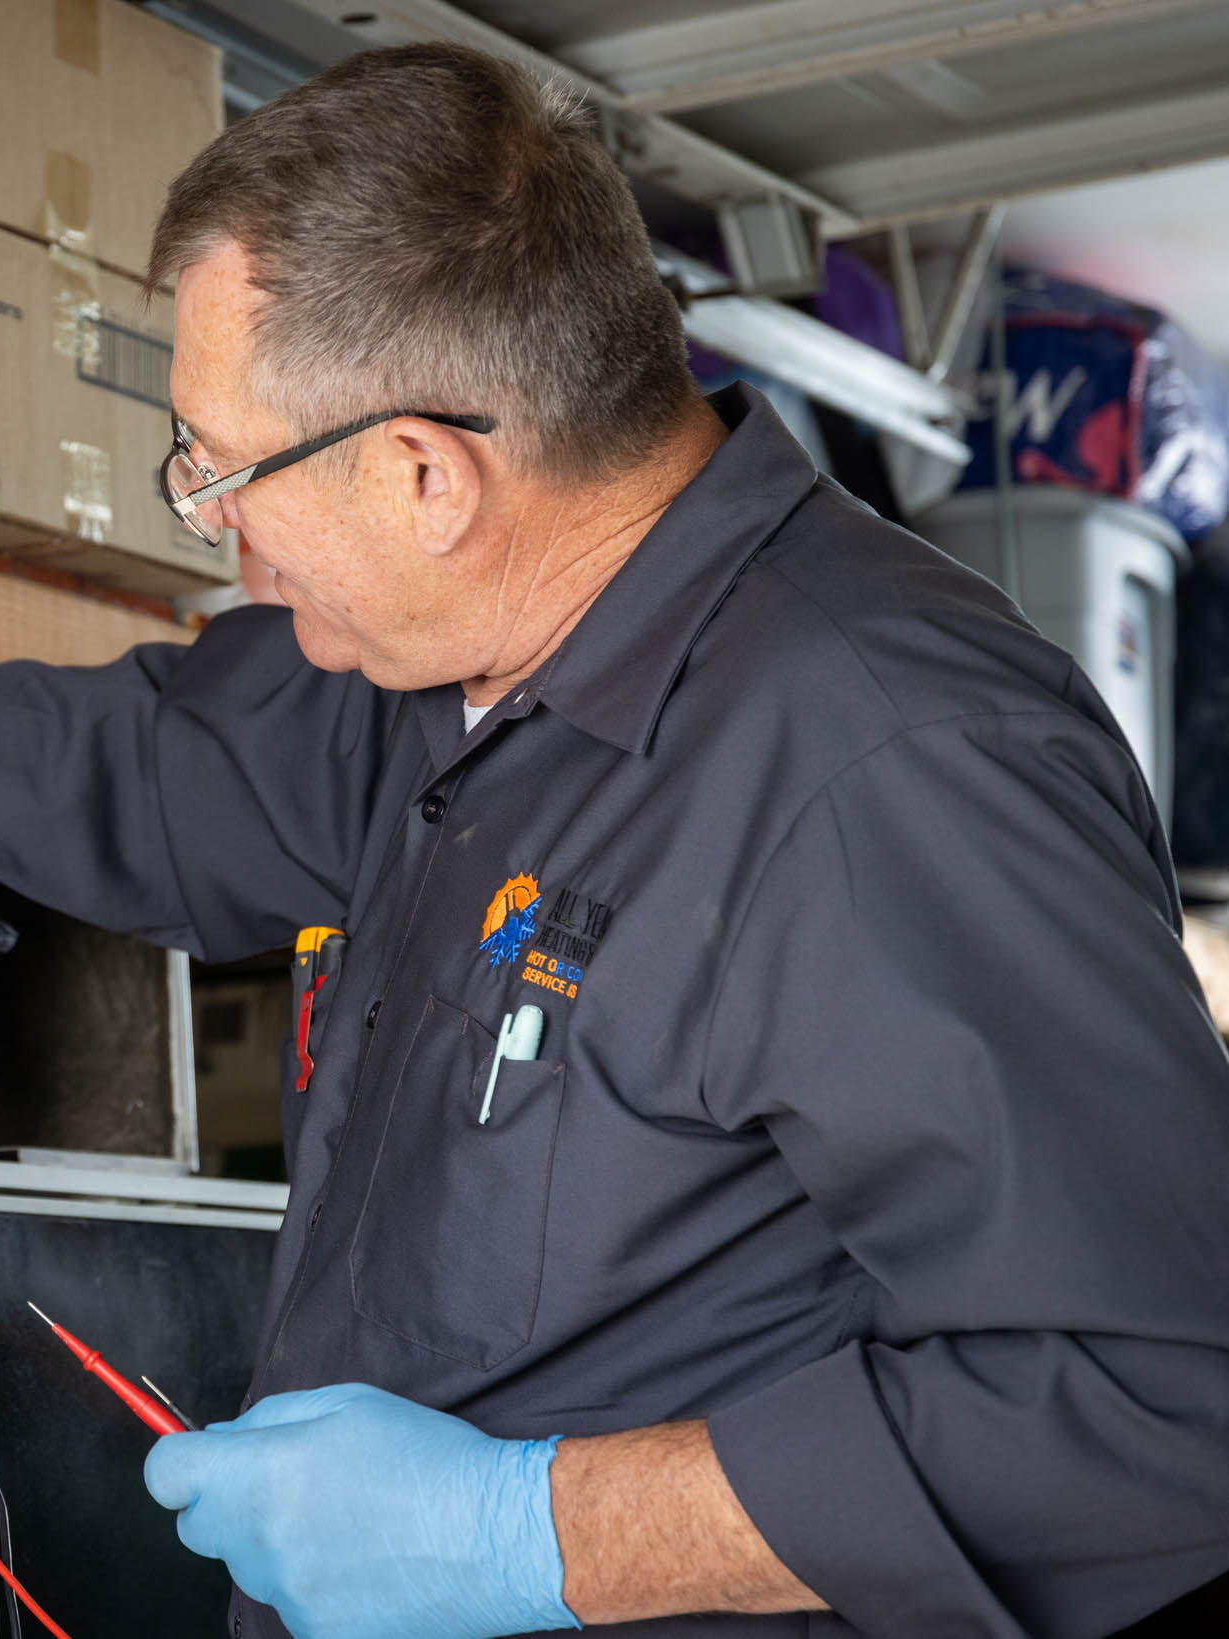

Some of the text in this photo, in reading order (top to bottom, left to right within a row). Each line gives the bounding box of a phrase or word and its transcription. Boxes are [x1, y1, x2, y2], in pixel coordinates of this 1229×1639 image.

[548, 888, 579, 928] ALL
[526, 949, 548, 968] HOT
[547, 957, 566, 976] OR
[522, 966, 567, 994] SERVICE
